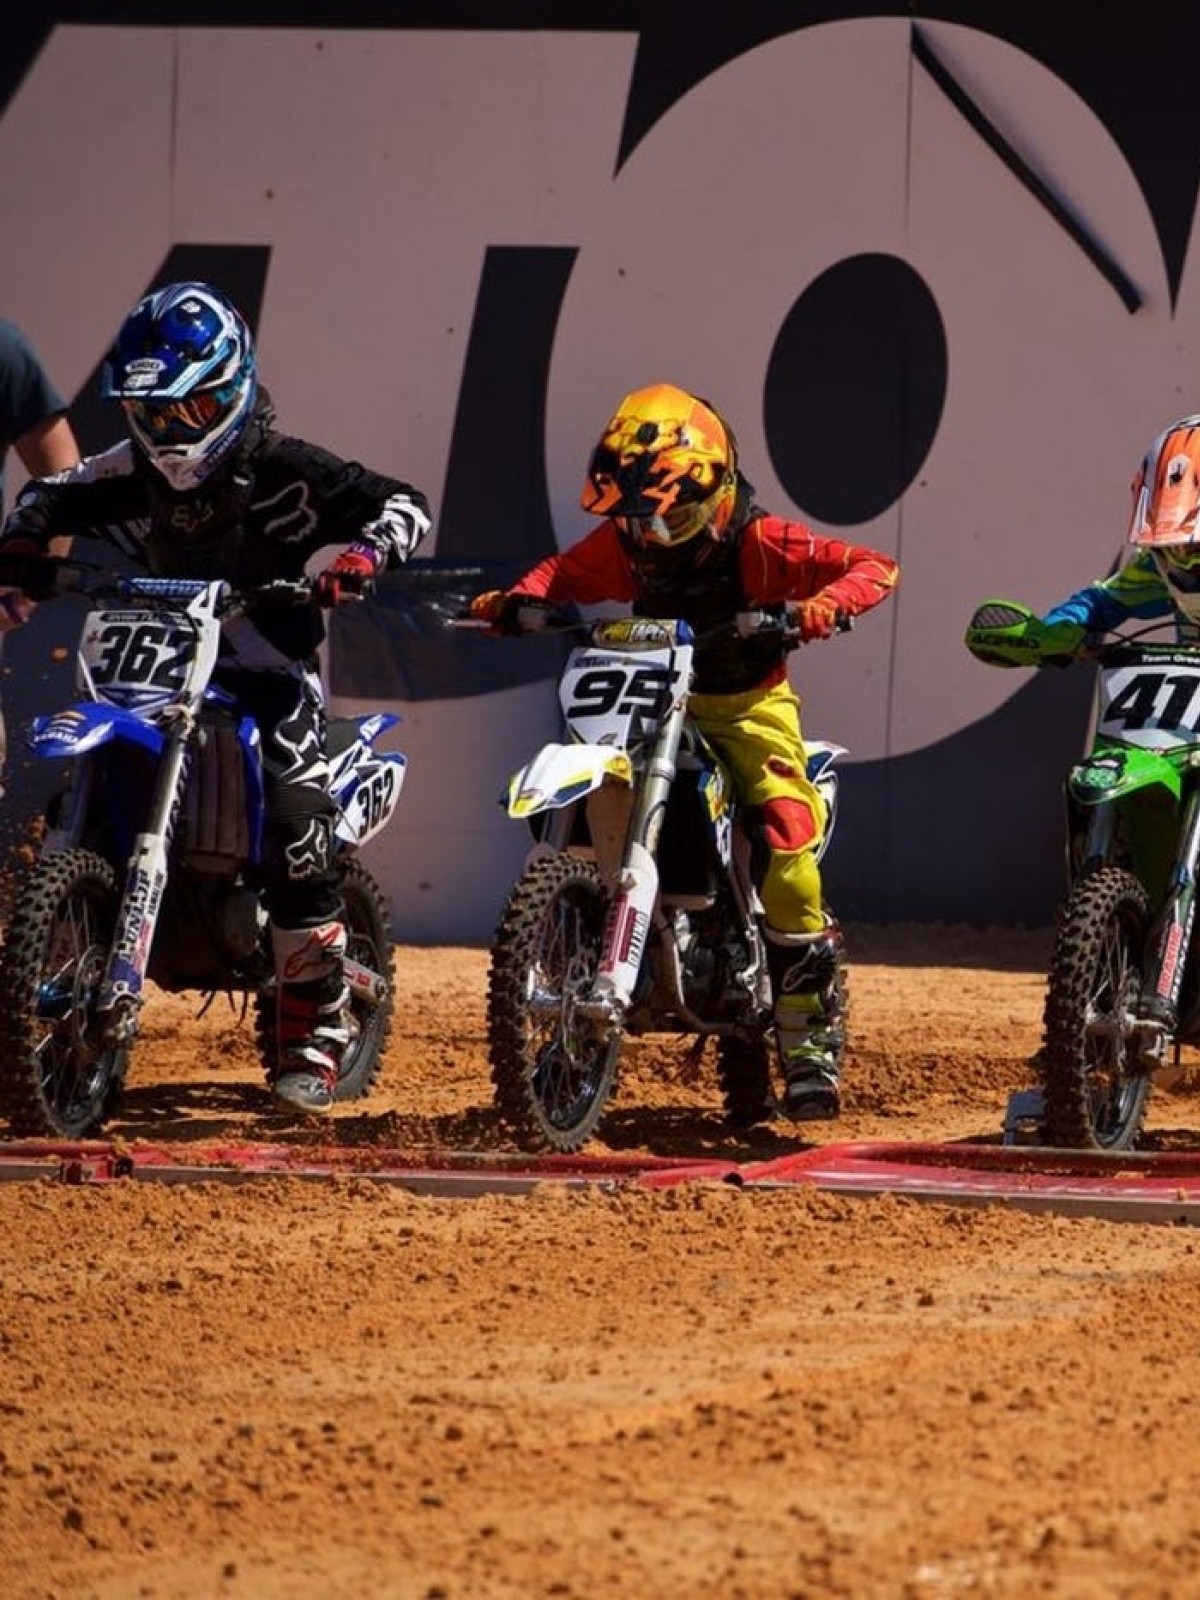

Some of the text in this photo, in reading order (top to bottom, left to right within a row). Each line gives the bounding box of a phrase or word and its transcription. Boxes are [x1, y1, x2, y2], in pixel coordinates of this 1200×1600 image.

[90, 625, 196, 689] 362
[1141, 654, 1171, 663] Team
[566, 669, 680, 719] 95
[357, 767, 394, 839] 362
